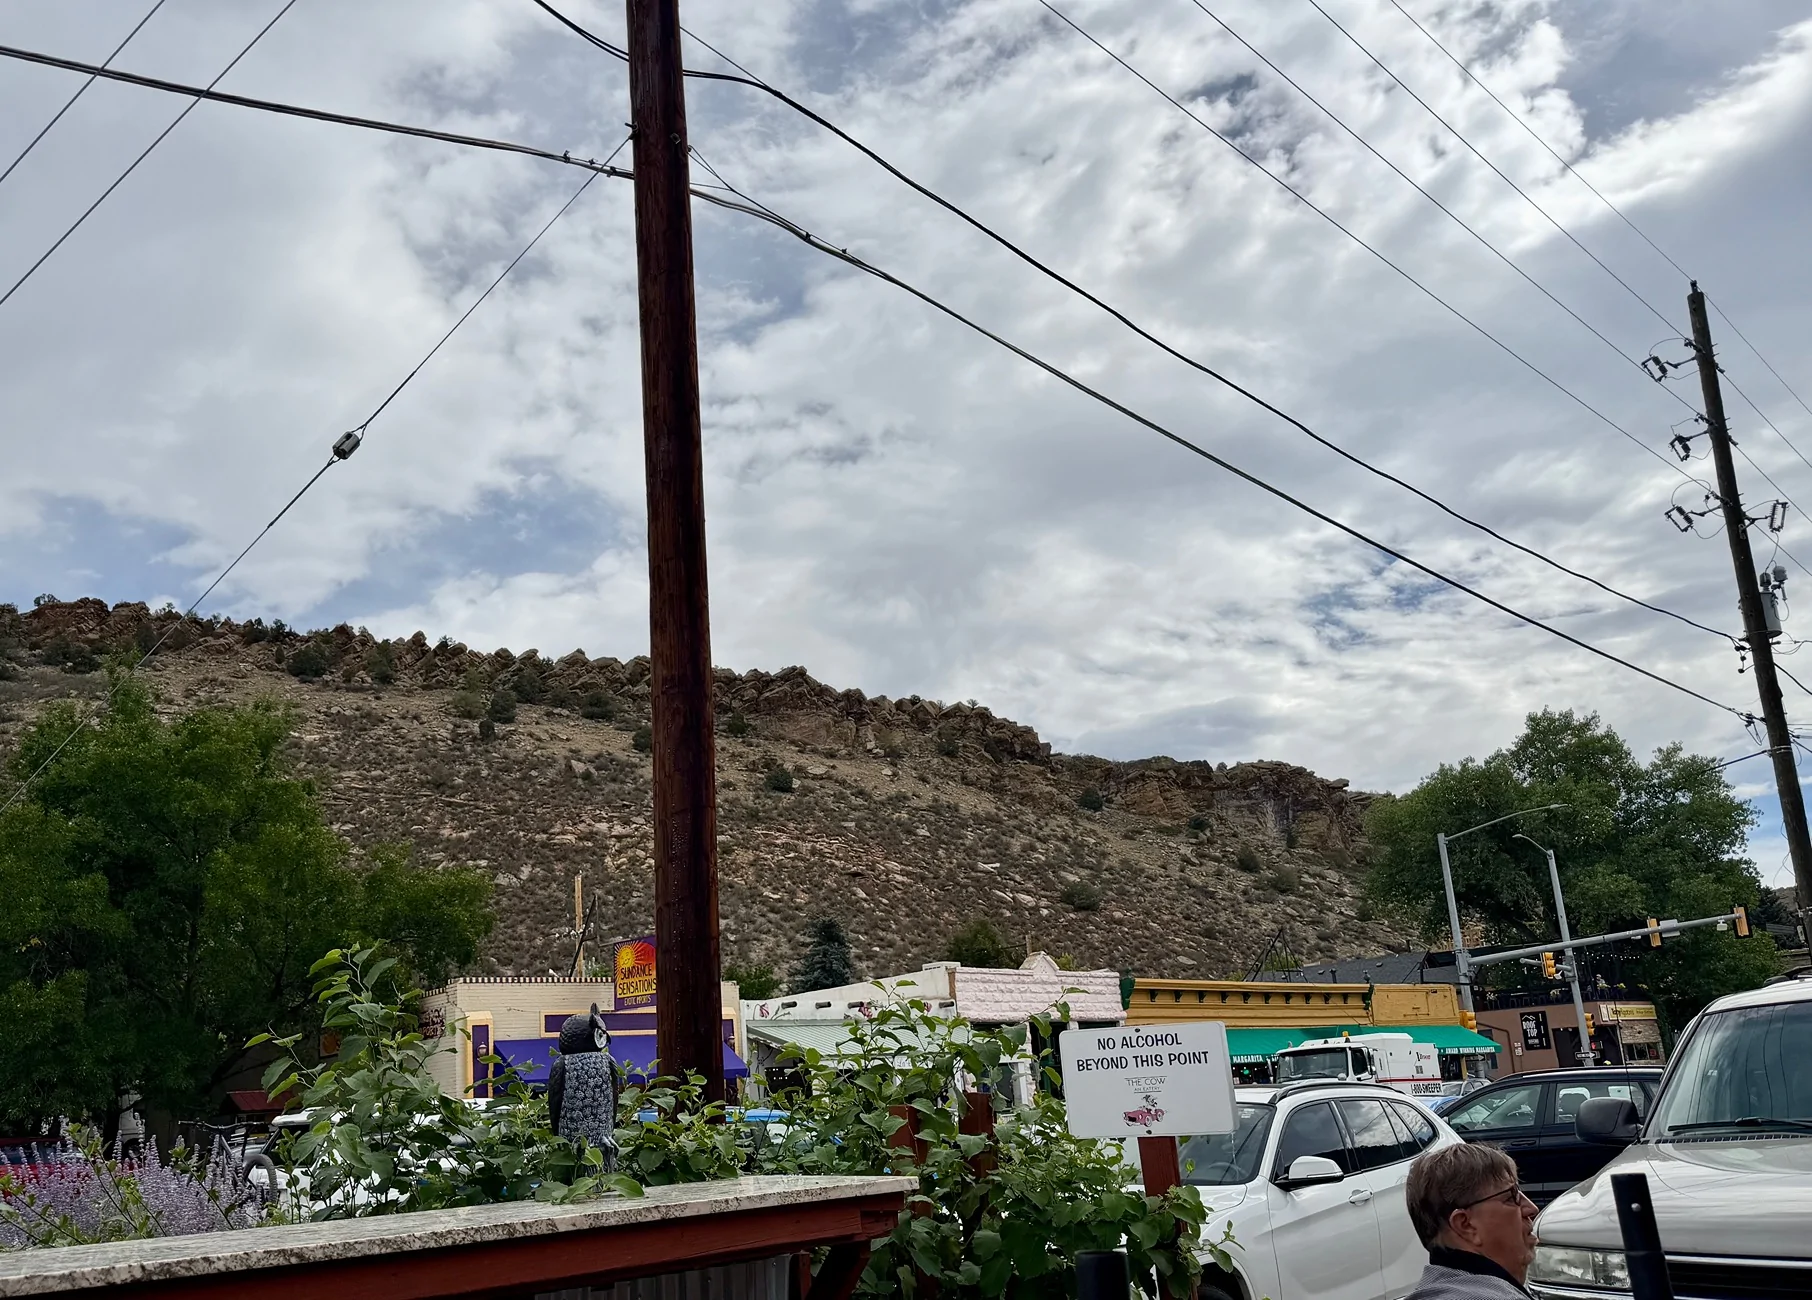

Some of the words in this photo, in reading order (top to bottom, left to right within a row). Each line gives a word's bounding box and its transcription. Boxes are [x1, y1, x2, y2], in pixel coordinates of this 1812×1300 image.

[620, 963, 652, 980] SUNDANCE
[618, 978, 657, 995] SENSATIONS
[1526, 1028, 1538, 1037] TOP
[1097, 1037, 1116, 1050] NO
[1121, 1033, 1182, 1049] ALCOHOL
[1076, 1056, 1128, 1072] BEYOND
[1132, 1054, 1164, 1068] THIS
[1168, 1051, 1209, 1066] POINT
[1232, 1054, 1264, 1063] MARGARITA
[1144, 1077, 1166, 1086] COW
[1410, 1083, 1442, 1095] 1-800-SWEEPER
